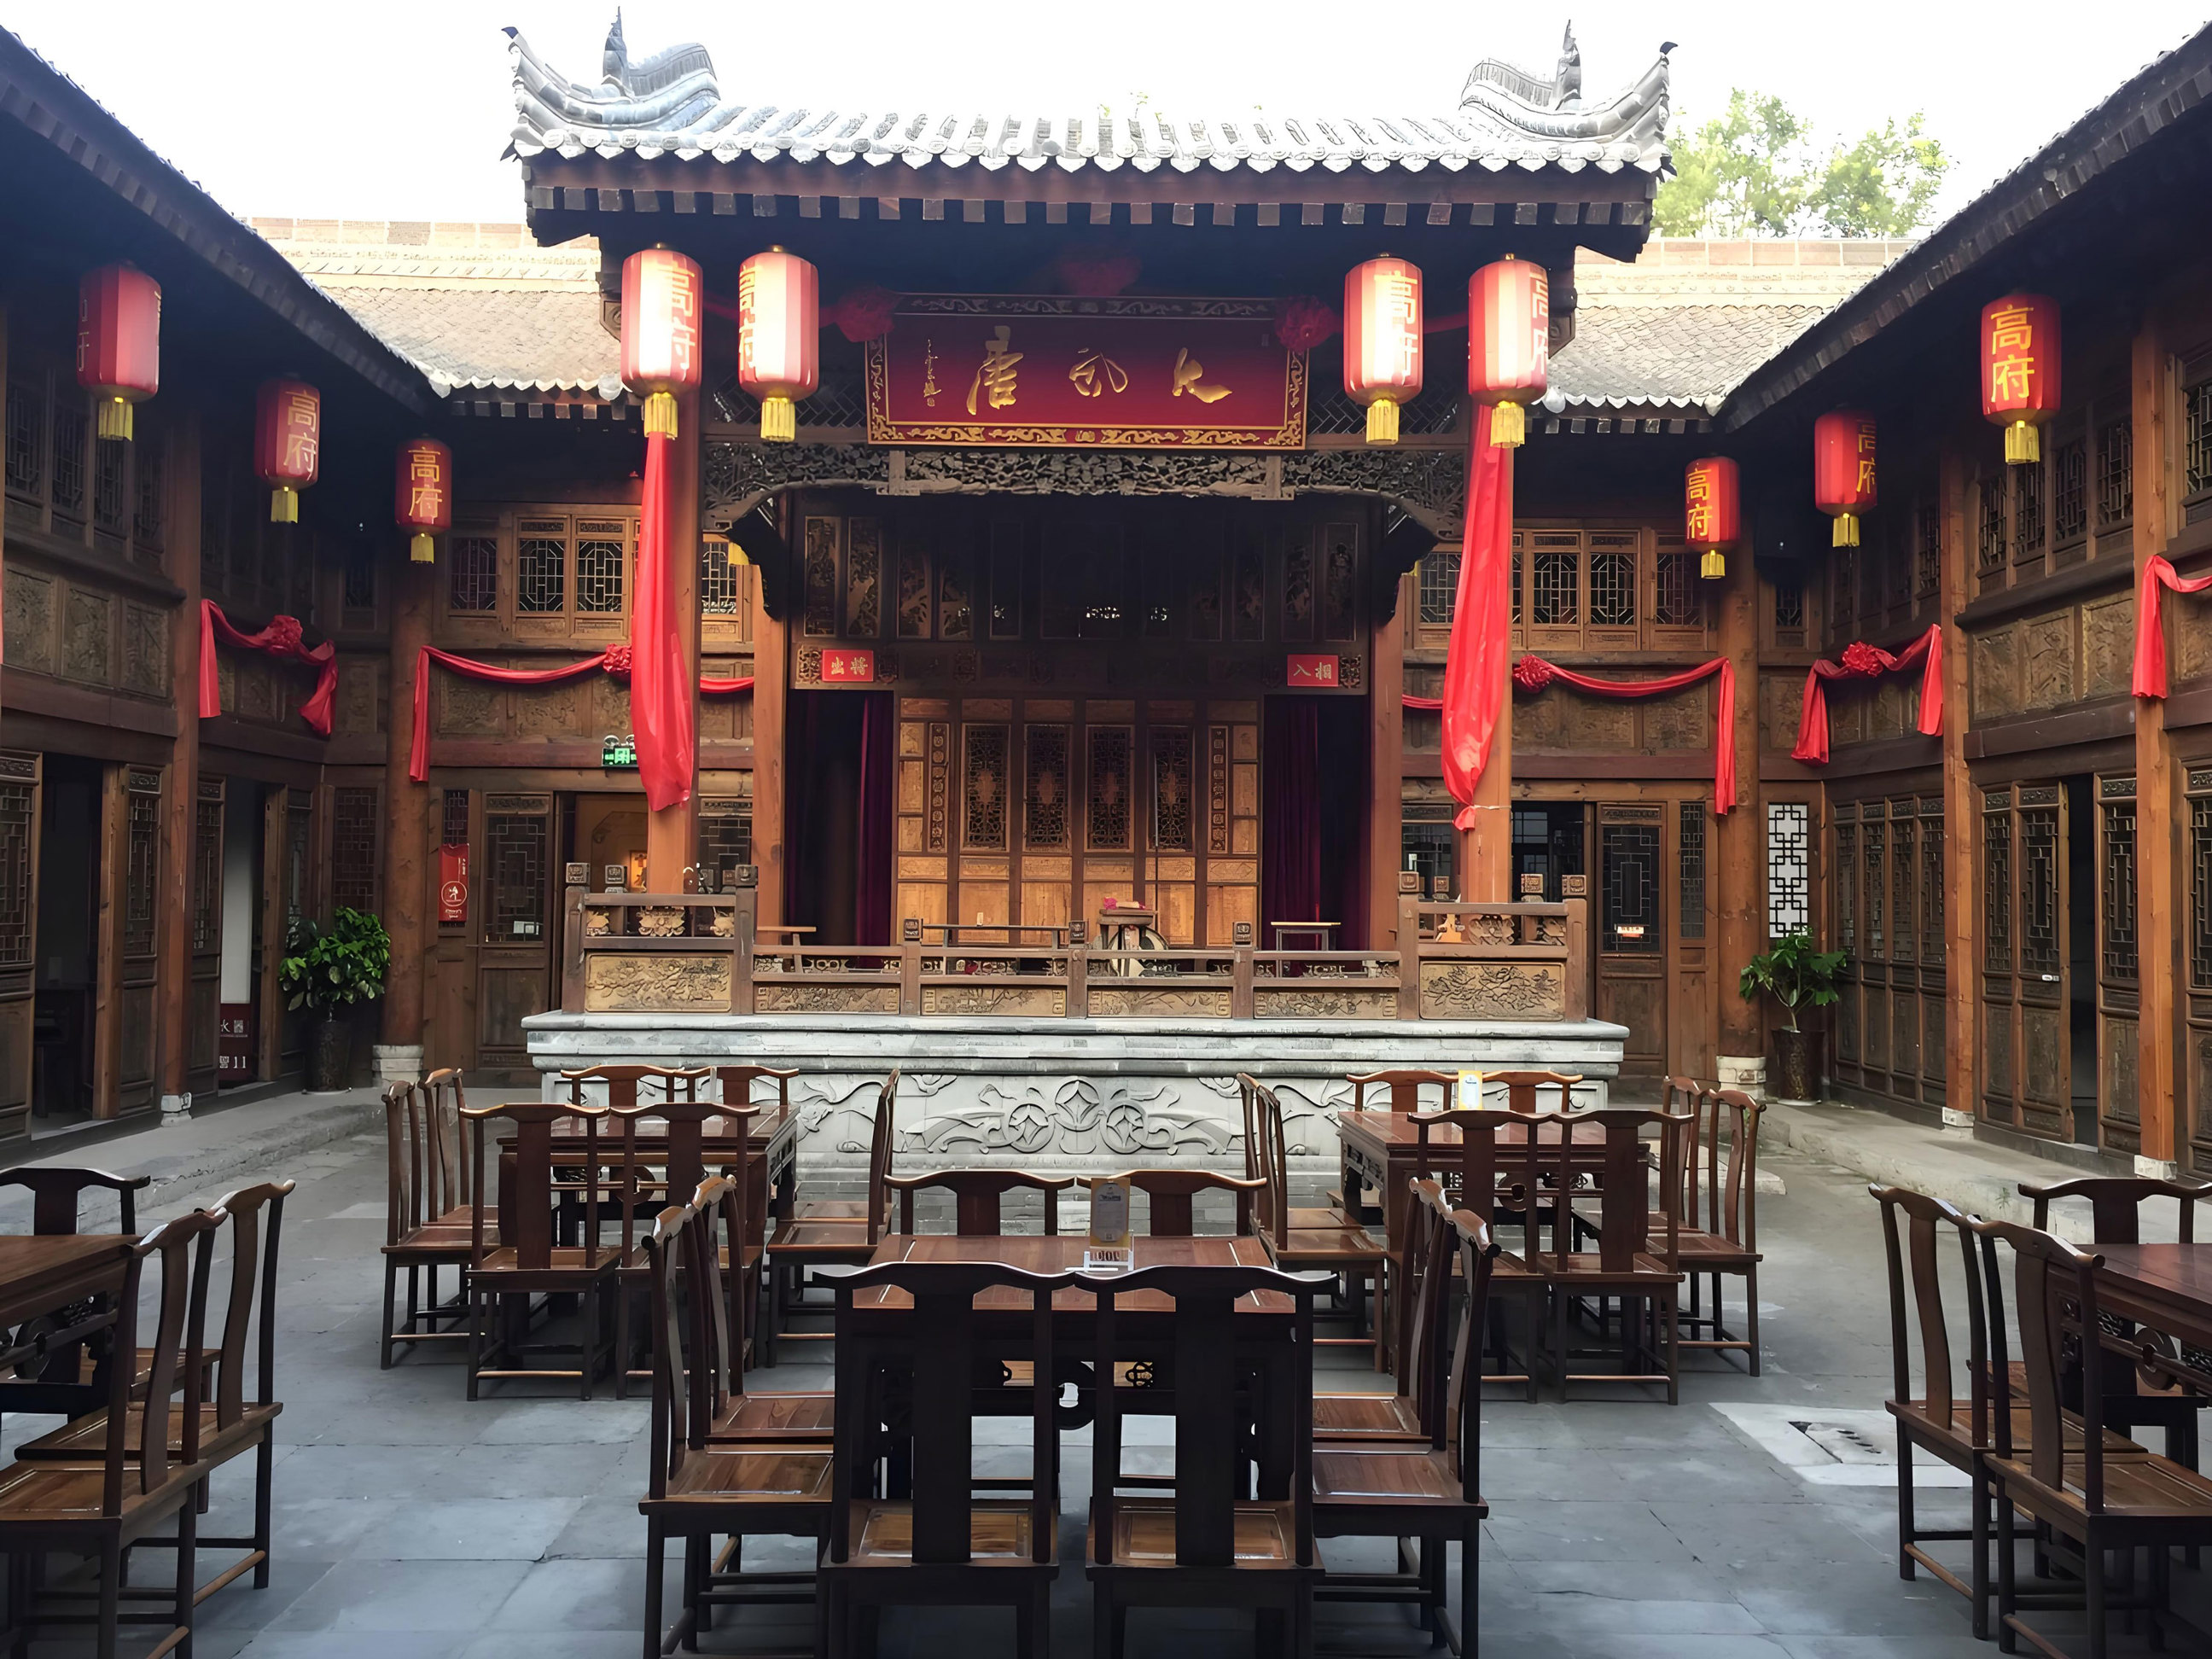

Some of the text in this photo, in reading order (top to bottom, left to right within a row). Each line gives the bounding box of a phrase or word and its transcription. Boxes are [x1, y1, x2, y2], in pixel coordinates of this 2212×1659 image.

[1991, 304, 2034, 404] 高府
[283, 389, 317, 474] 高府
[408, 446, 442, 518] 高府
[1687, 467, 1713, 540] 高府
[1293, 661, 1332, 680] 入相
